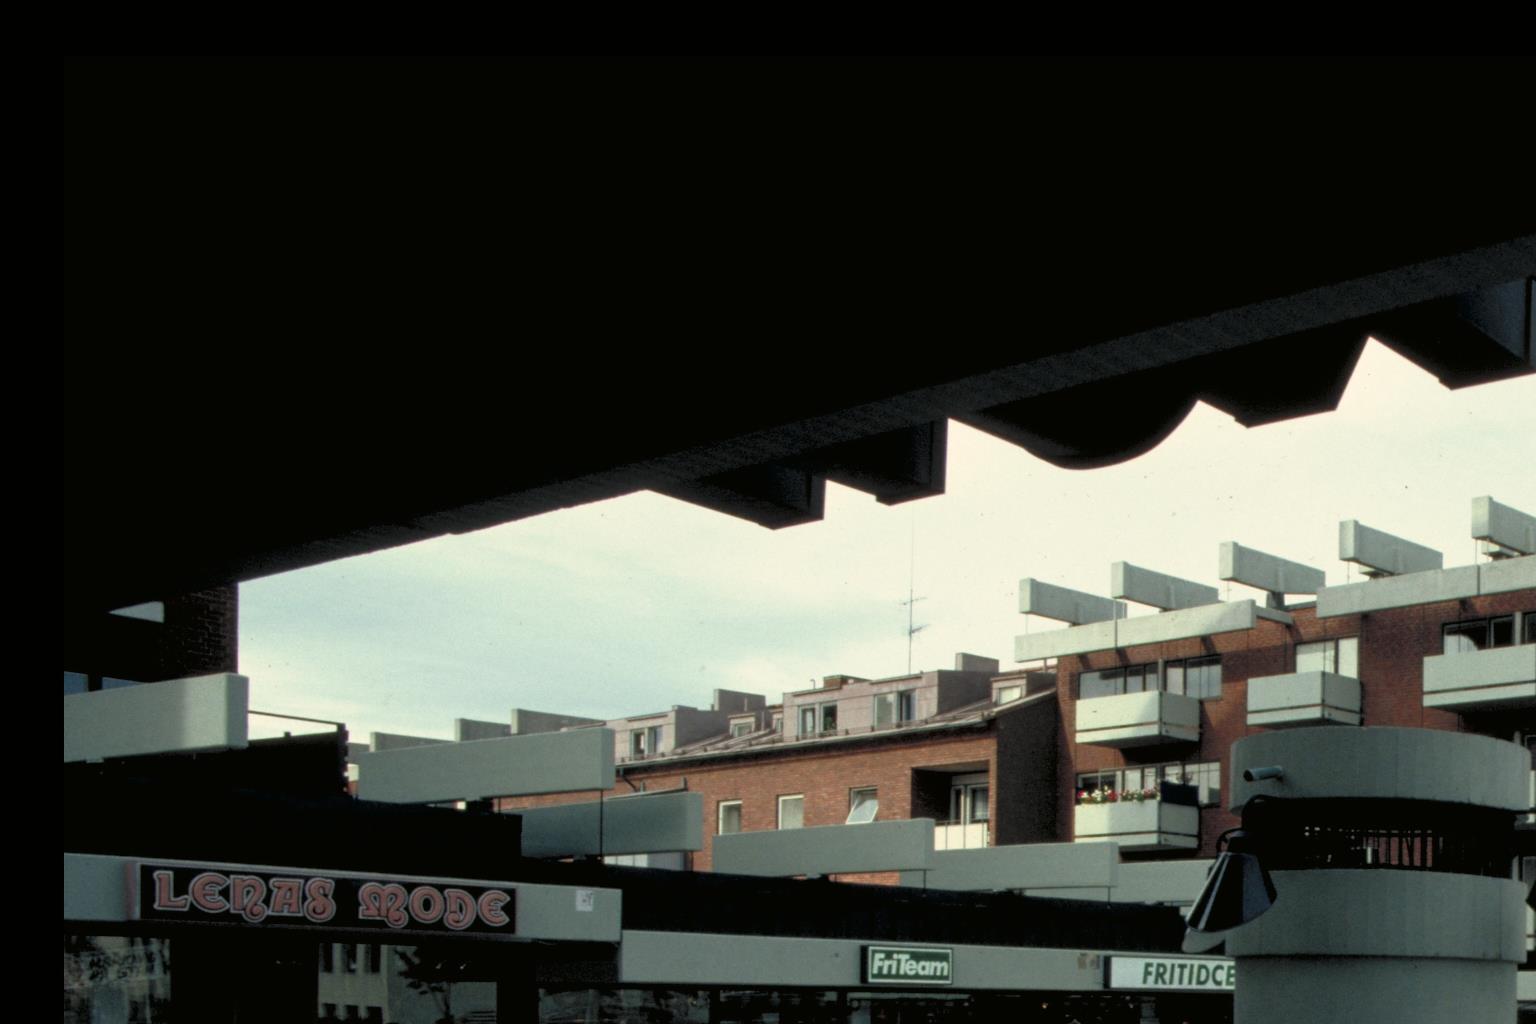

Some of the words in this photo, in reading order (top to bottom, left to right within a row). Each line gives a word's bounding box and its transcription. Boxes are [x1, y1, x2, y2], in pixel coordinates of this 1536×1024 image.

[153, 870, 336, 923] LENAS
[358, 881, 511, 930] MODE
[872, 952, 949, 977] FriTeam
